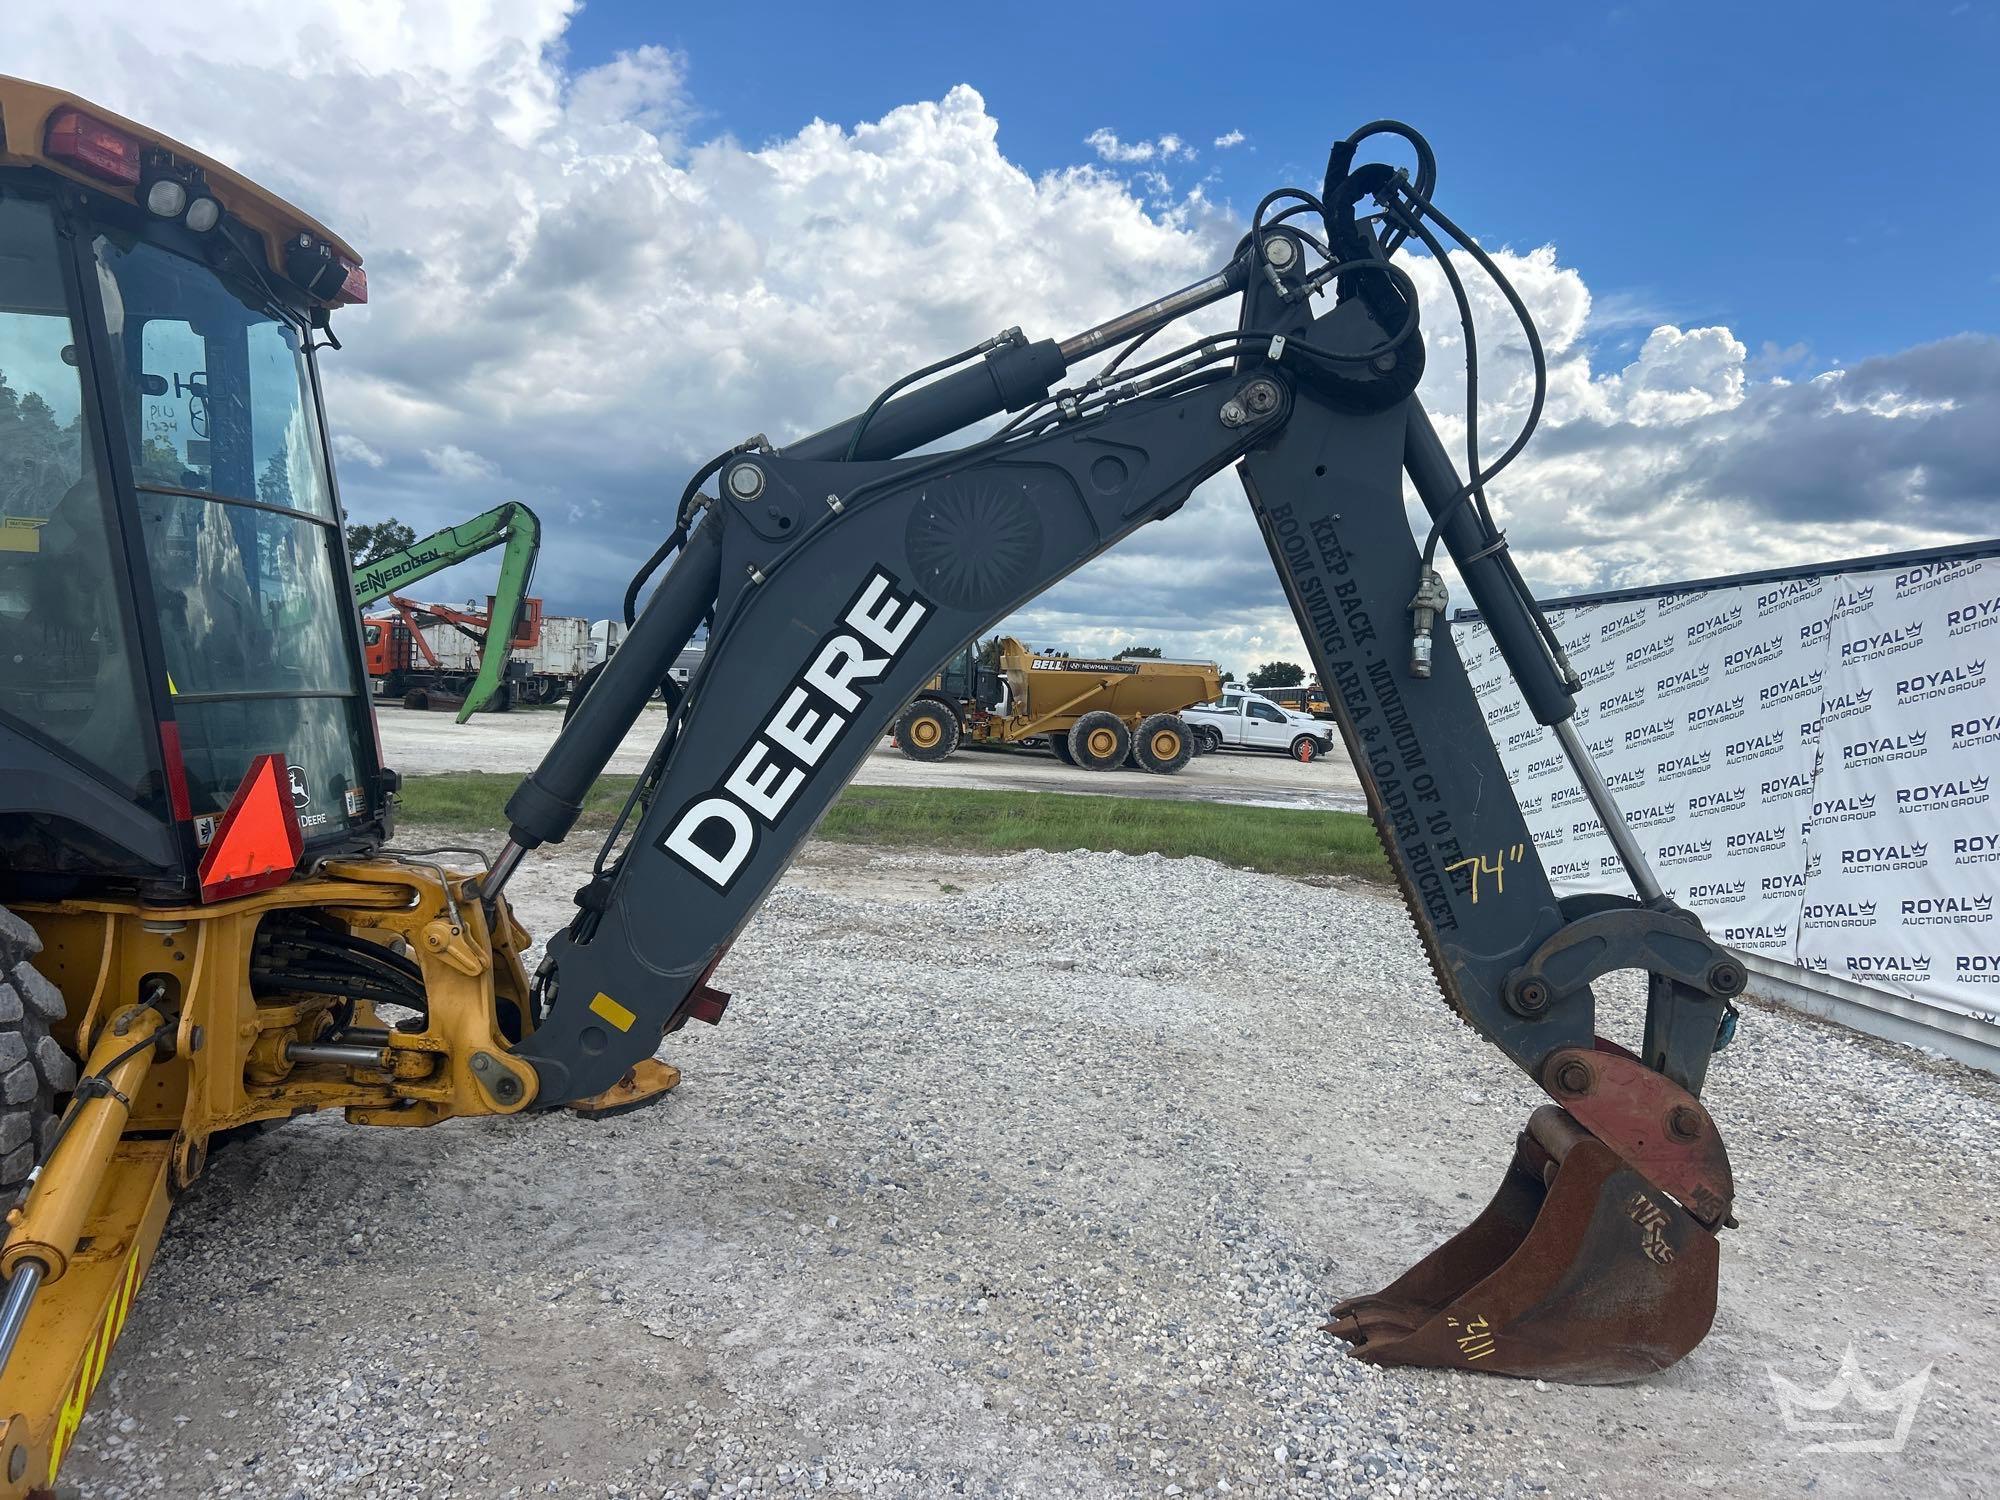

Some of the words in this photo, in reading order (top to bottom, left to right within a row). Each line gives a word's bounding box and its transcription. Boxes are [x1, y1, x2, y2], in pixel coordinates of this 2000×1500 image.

[1271, 501, 1315, 576] BOOM
[1309, 515, 1349, 576] KEEP
[1896, 580, 1941, 600] AUCTION
[1943, 564, 1982, 583] GROUP
[1758, 580, 1808, 609] ROYAL
[1759, 599, 1792, 618] AUCTION
[1793, 587, 1822, 603] GROUP
[1300, 576, 1347, 656] SWING
[1334, 578, 1377, 647] BACK
[1601, 613, 1636, 635] ROYAL
[1688, 613, 1729, 638] ROYAL
[1688, 630, 1717, 646] AUCTION
[1718, 620, 1743, 635] GROUP
[1949, 616, 1998, 637] AUCTION
[1626, 641, 1663, 663] ROYAL
[1842, 629, 1904, 657] ROYAL
[1626, 657, 1651, 670] AUCTION
[1652, 648, 1674, 660] GROUP
[1724, 642, 1771, 667] ROYAL
[1842, 649, 1885, 667] AUCTION
[1887, 639, 1923, 655] GROUP
[1031, 659, 1062, 671] BELL
[1725, 659, 1757, 676] AUCTION
[1758, 650, 1783, 665] GROUP
[1579, 665, 1606, 681] OYAL
[1658, 669, 1698, 691] ROYAL
[1897, 667, 1966, 695] ROYAL
[1332, 660, 1372, 724] AREA
[1658, 685, 1686, 699] AUCTION
[1687, 677, 1709, 690] GROUP
[1760, 676, 1808, 701] ROYAL
[1760, 694, 1793, 710] AUCTION
[1794, 685, 1822, 700] GROUP
[1897, 688, 1946, 706] AUCTION
[1948, 678, 1986, 694] GROUP
[1600, 692, 1634, 711] ROYAL
[1841, 704, 1871, 718] GROUP
[1366, 658, 1427, 773] MINIMUM
[1488, 704, 1513, 720] ROYAL
[1688, 701, 1731, 723] ROYAL
[1689, 718, 1718, 731] AUCTION
[1720, 710, 1744, 722] GROUP
[664, 573, 927, 887] DEERE
[1359, 725, 1381, 743] &
[1508, 729, 1535, 745] ROYAL
[1625, 722, 1663, 742] ROYAL
[1625, 736, 1651, 750] AUCTION
[1652, 731, 1675, 742] GROUP
[1726, 735, 1772, 756] ROYAL
[1843, 737, 1908, 759] ROYAL
[1952, 733, 2000, 750] AUCTION
[1527, 757, 1556, 773] ROYAL
[1658, 755, 1699, 774] ROYAL
[1726, 752, 1759, 766] AUCTION
[1760, 745, 1784, 757] GROUP
[1844, 755, 1884, 770] AUCTION
[1887, 748, 1928, 761] GROUP
[1606, 772, 1634, 787] OYAL
[1658, 771, 1686, 782] AUCTION
[1687, 764, 1711, 775] GROUP
[1368, 745, 1420, 842] LOADER
[1412, 774, 1441, 804] OF
[1625, 781, 1645, 791] GROUP
[1761, 774, 1809, 794] ROYAL
[1897, 781, 1969, 803] ROYAL
[1551, 786, 1581, 802] ROYAL
[1689, 791, 1733, 810] ROYAL
[1762, 791, 1793, 804] AUCTION
[1689, 807, 1719, 818] AUCTION
[1721, 802, 1745, 813] GROUP
[1813, 798, 1859, 816] OYAL
[1898, 800, 1949, 814] AUCTION
[1951, 794, 1990, 808] GROUP
[1425, 809, 1452, 836] 10
[1626, 806, 1664, 822] ROYAL
[1628, 821, 1653, 830] UCTION
[1654, 815, 1676, 825] GROUP
[1810, 816, 1839, 826] UCTION
[1840, 811, 1876, 822] GROUP
[1530, 829, 1556, 843] OYAL
[1572, 820, 1603, 834] ROYA
[1727, 830, 1774, 848] ROYAL
[1659, 842, 1700, 858] ROYAL
[1727, 846, 1759, 857] AUCTION
[1760, 842, 1785, 852] GROUP
[1842, 846, 1911, 864] ROYAL
[1437, 836, 1473, 897] FEET
[1550, 861, 1581, 875] ROYAL
[1660, 857, 1687, 867] AUCTION
[1689, 854, 1712, 863] GROUP
[1842, 863, 1890, 874] AUCTION
[1892, 860, 1928, 870] GROUP
[1405, 841, 1459, 932] BUCKET
[1690, 883, 1733, 898] ROYAL
[1762, 890, 1796, 900] AUCTION
[1689, 898, 1719, 907] AUCTION
[1720, 895, 1745, 904] GROUP
[1901, 897, 1972, 914] ROYAL
[1803, 904, 1858, 918] ROYAL
[1901, 916, 1951, 925] AUCTION
[1953, 914, 1993, 923] GROUP
[1725, 927, 1772, 940] ROYAL
[1804, 920, 1839, 929] AUCTION
[1841, 919, 1877, 927] GROUP
[1760, 940, 1787, 948] GROUP
[1847, 957, 1911, 971] ROYAL
[1892, 973, 1930, 981] GROUP
[1956, 975, 2000, 983] AUCTIO
